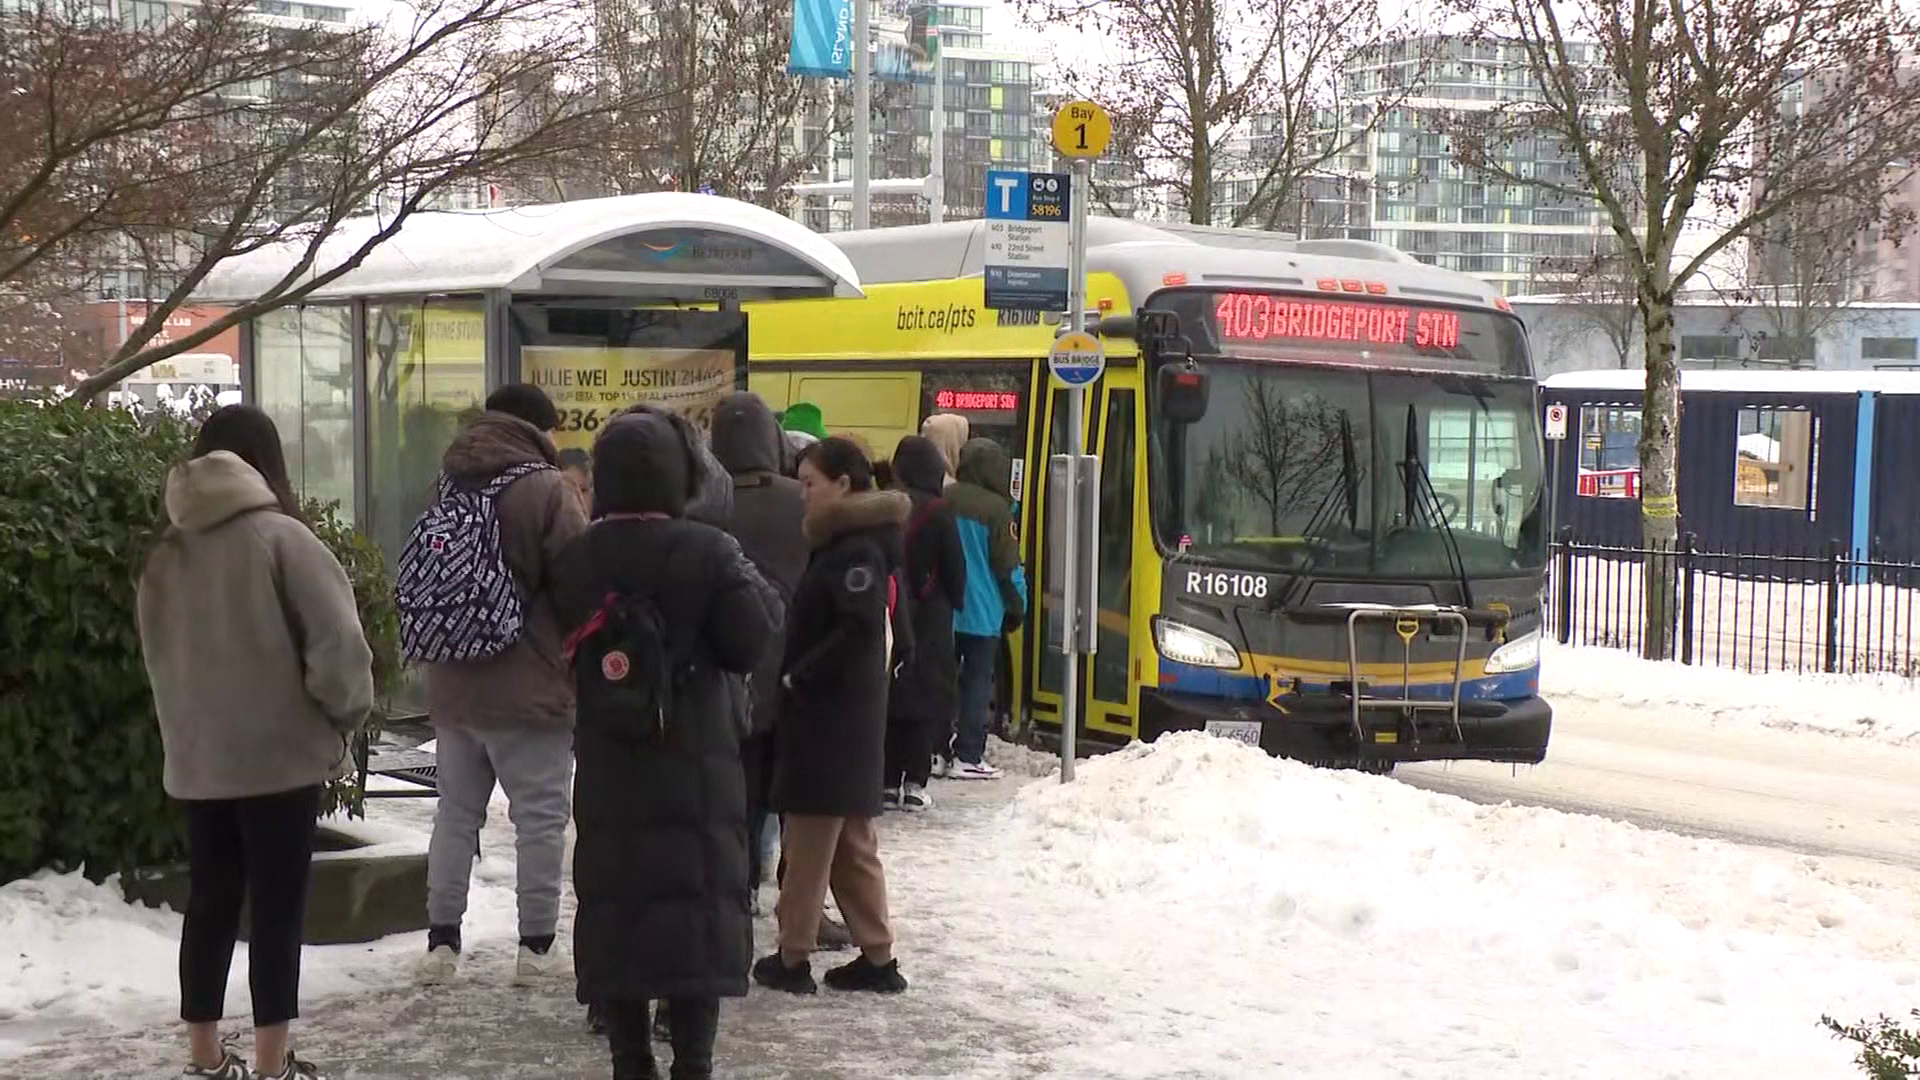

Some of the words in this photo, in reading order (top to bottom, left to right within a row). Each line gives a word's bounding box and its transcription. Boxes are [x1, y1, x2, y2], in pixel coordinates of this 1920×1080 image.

[1071, 107, 1094, 121] Bay
[1074, 123, 1088, 149] 1
[994, 178, 1018, 212] T
[1032, 204, 1061, 216] 58196
[1008, 225, 1042, 234] Bridgeport
[897, 303, 976, 335] bcit.ca/pts
[1216, 292, 1271, 340] 403
[1273, 302, 1410, 344] BRIDGEPORT
[1416, 311, 1459, 348] STN
[1053, 352, 1070, 365] BUS
[531, 368, 573, 386] JULIE
[576, 369, 608, 386] WEI
[620, 369, 676, 387] JUSTIN
[600, 391, 619, 401] TOP
[936, 390, 953, 408] 403
[955, 392, 999, 409] BRIDGEPORT
[1001, 394, 1016, 410] STN
[1187, 571, 1268, 598] R16108
